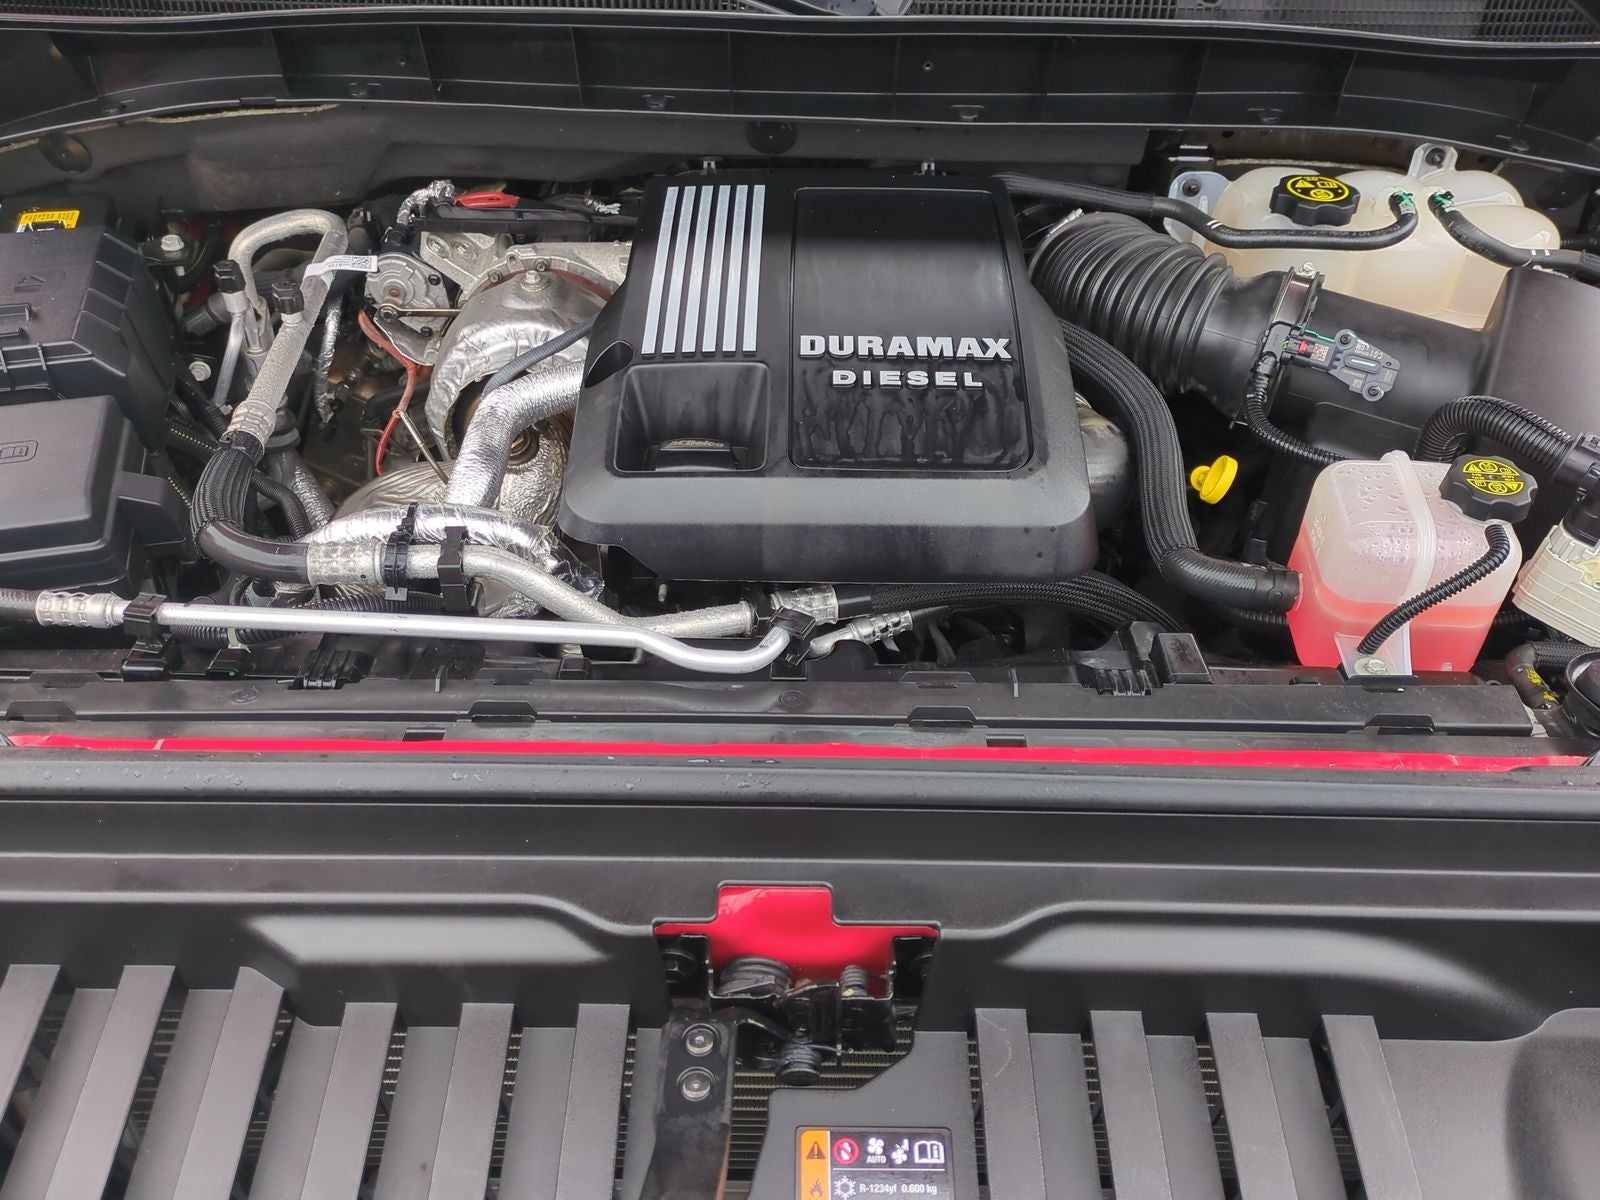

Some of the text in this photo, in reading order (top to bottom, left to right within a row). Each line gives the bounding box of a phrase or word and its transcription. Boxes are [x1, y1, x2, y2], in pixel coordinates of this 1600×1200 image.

[800, 335, 1013, 361] DURAMAX
[832, 370, 983, 388] DIESEL
[866, 1155, 887, 1164] AUTO
[859, 1183, 938, 1195] R-1234yf 0.600 kg
